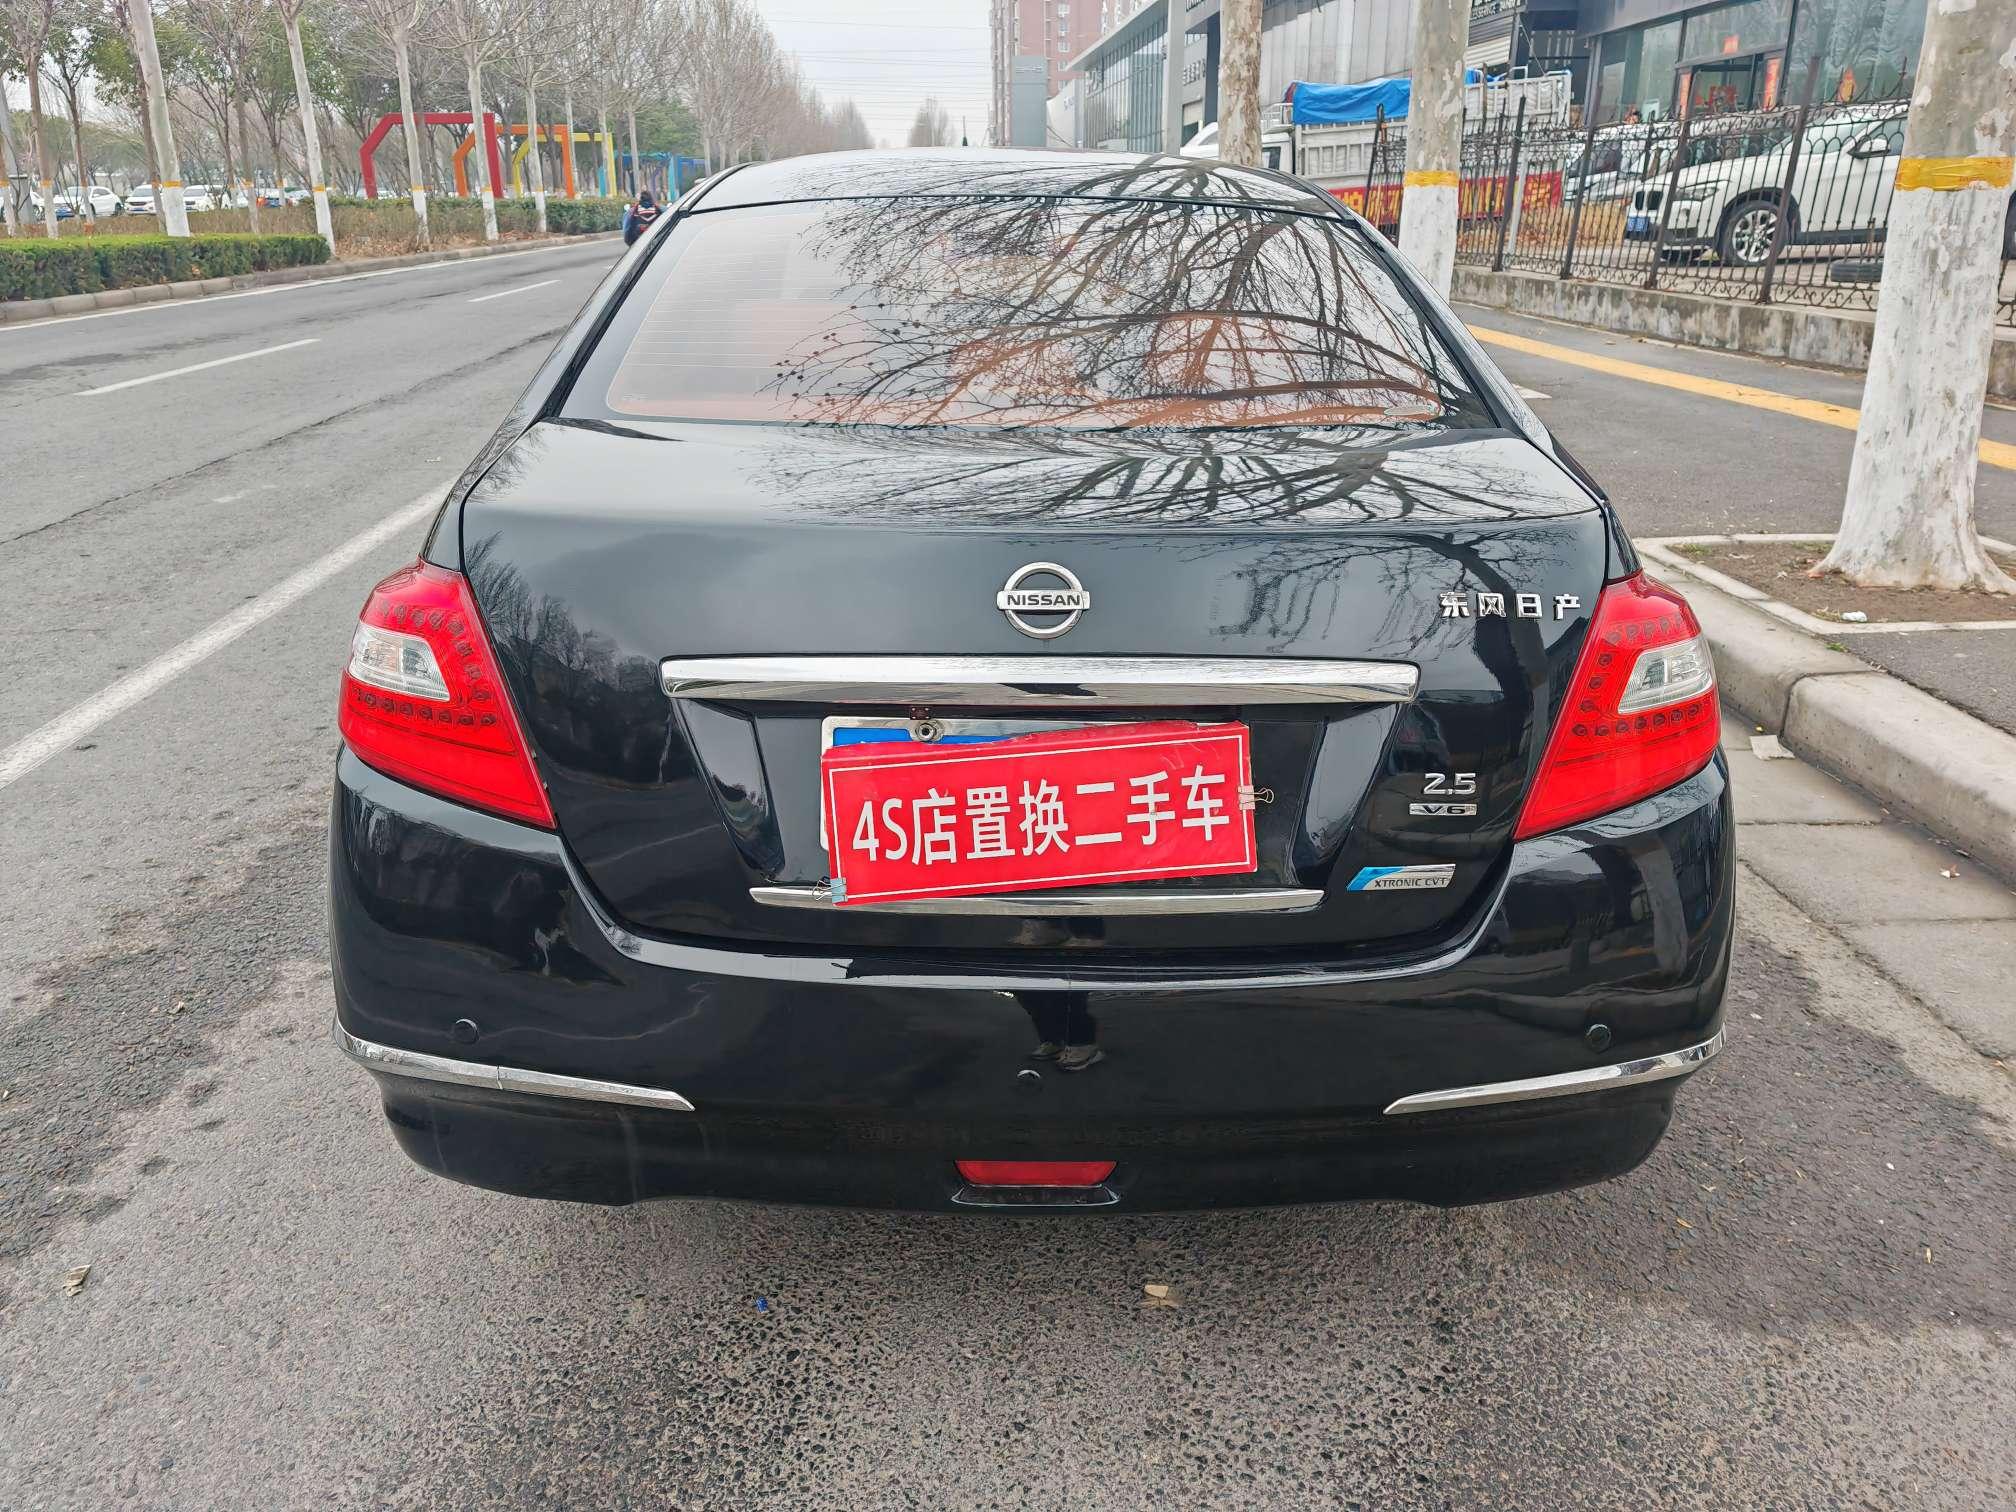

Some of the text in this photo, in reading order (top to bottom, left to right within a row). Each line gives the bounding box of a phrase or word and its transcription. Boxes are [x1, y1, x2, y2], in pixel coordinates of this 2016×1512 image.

[1007, 594, 1081, 606] NISSAN
[1440, 591, 1581, 621] 东风日产
[1423, 772, 1477, 796] 2.5
[852, 764, 1230, 866] 4S店置换二手车
[1374, 876, 1449, 888] XTRONIC CVT
